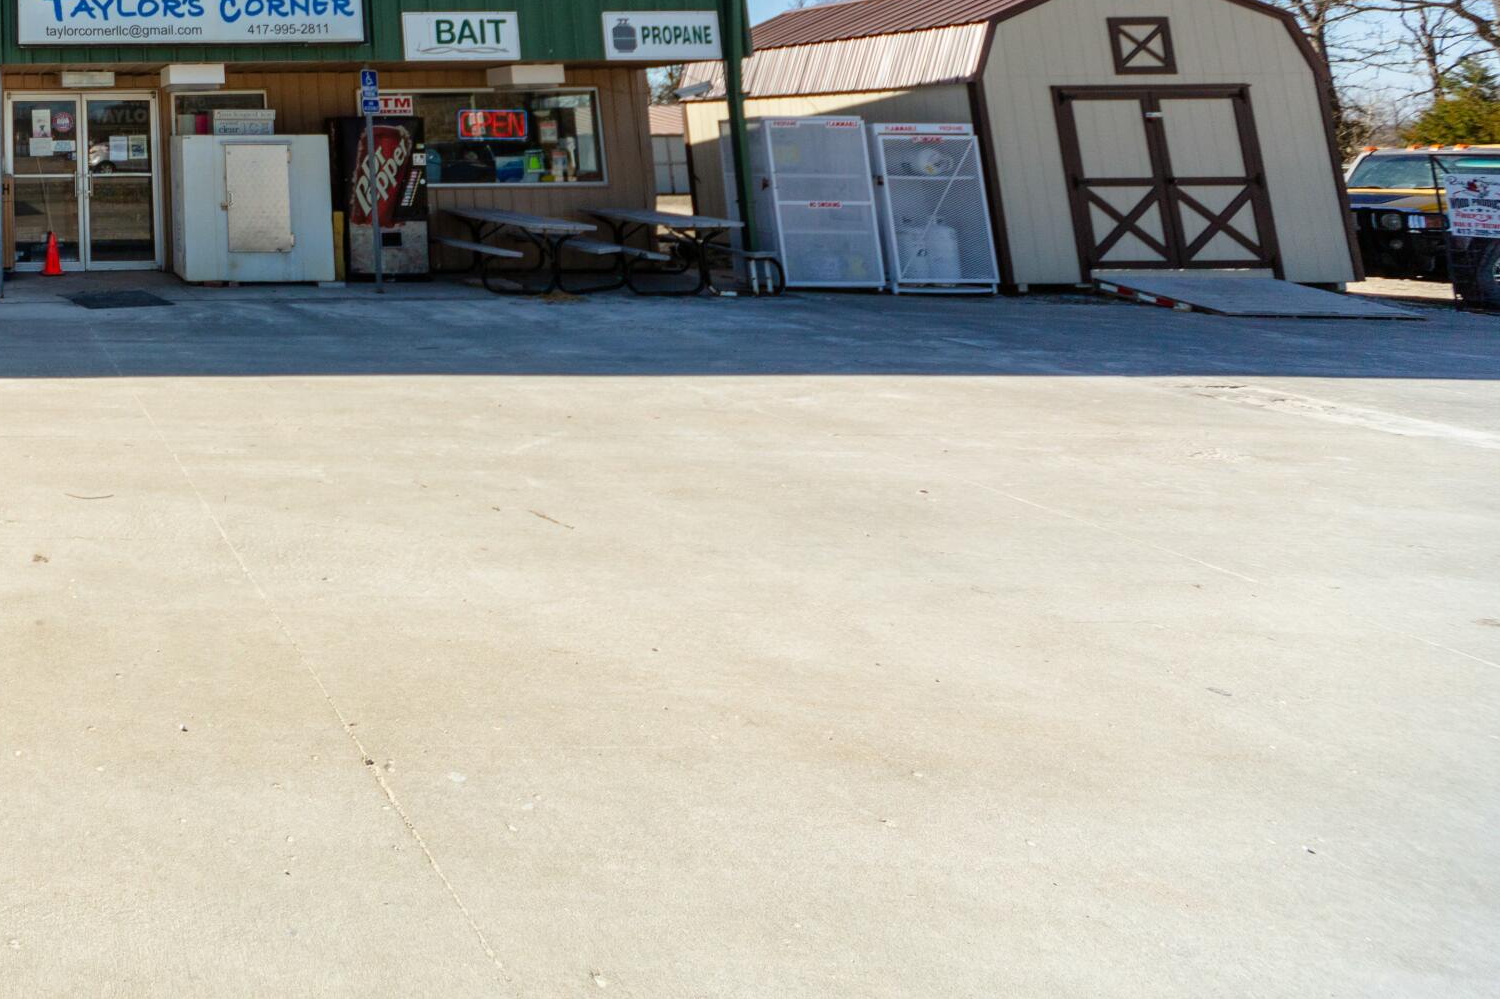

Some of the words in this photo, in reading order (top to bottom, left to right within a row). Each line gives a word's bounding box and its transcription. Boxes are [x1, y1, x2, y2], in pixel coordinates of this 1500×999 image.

[46, 24, 202, 39] taylorcornerllc@gmail.com
[247, 23, 329, 36] 417-995-2811
[435, 19, 507, 45] BAIT
[641, 25, 713, 45] PROPANE
[380, 97, 411, 109] TM
[460, 111, 526, 138] OPEN
